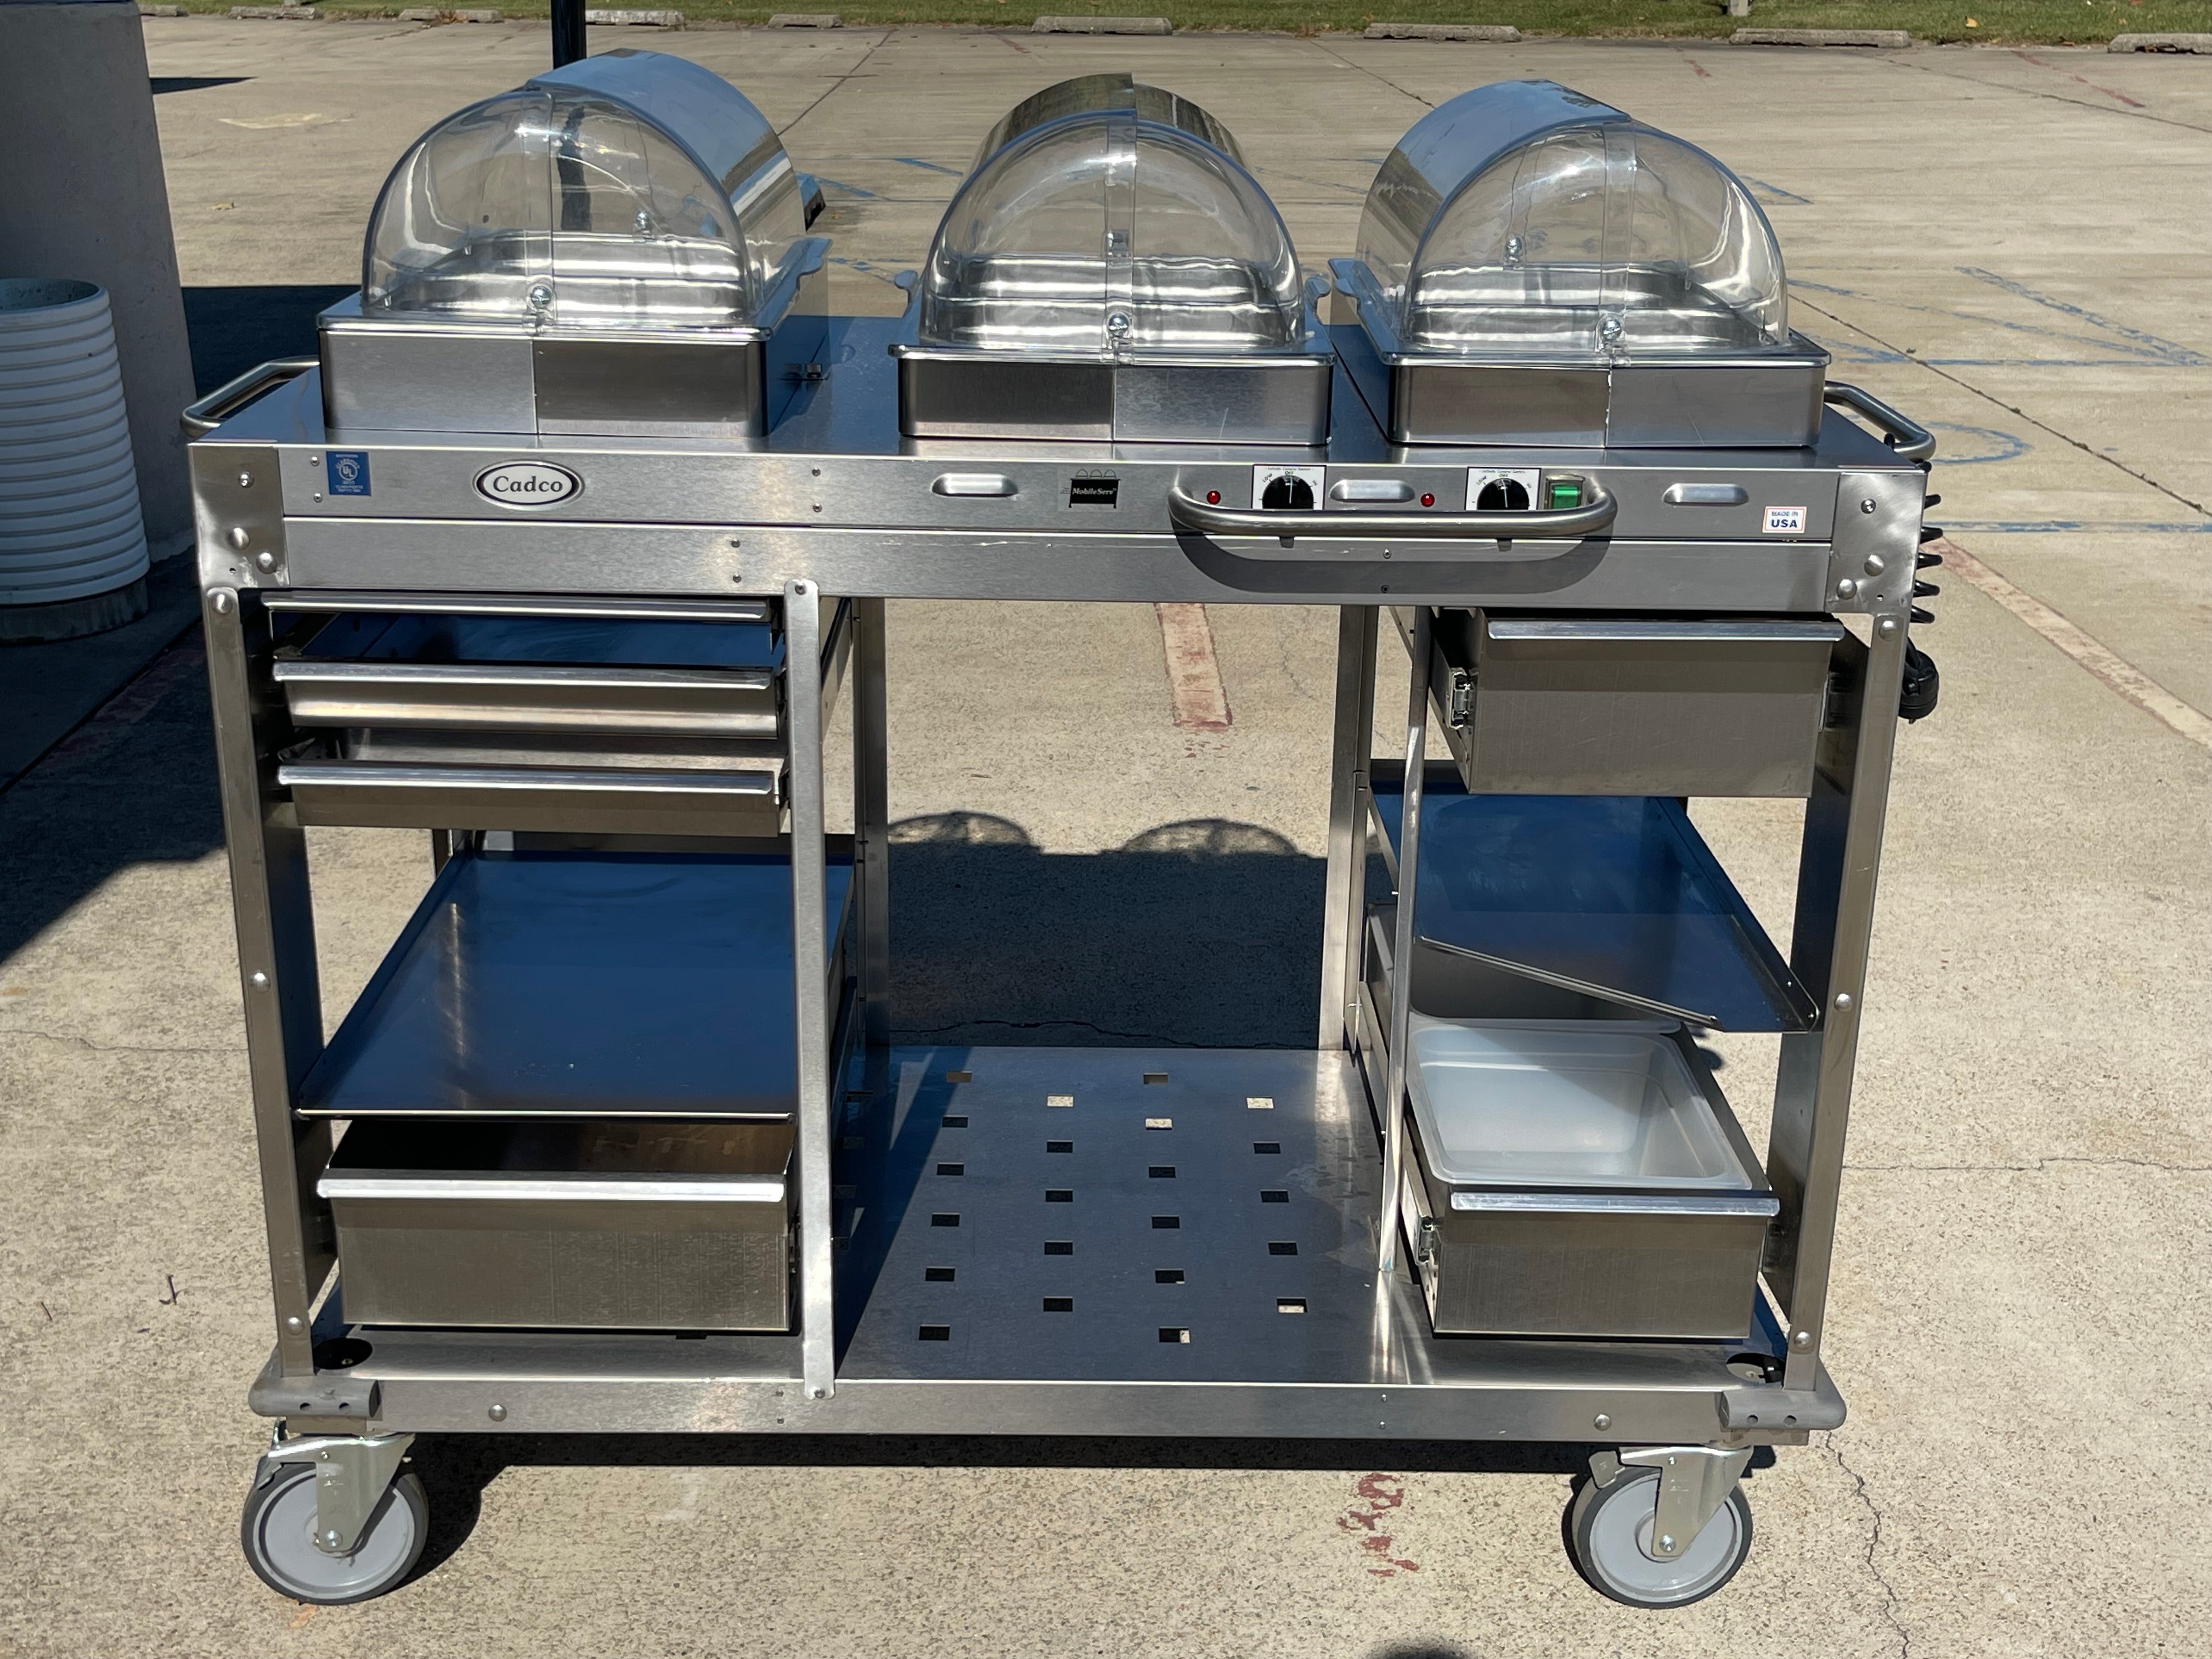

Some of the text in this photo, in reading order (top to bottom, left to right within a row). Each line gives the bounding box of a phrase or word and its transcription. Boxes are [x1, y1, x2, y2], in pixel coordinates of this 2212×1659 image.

[342, 466, 354, 477] UL
[493, 476, 563, 492] Cadco
[1771, 518, 1797, 528] USA
